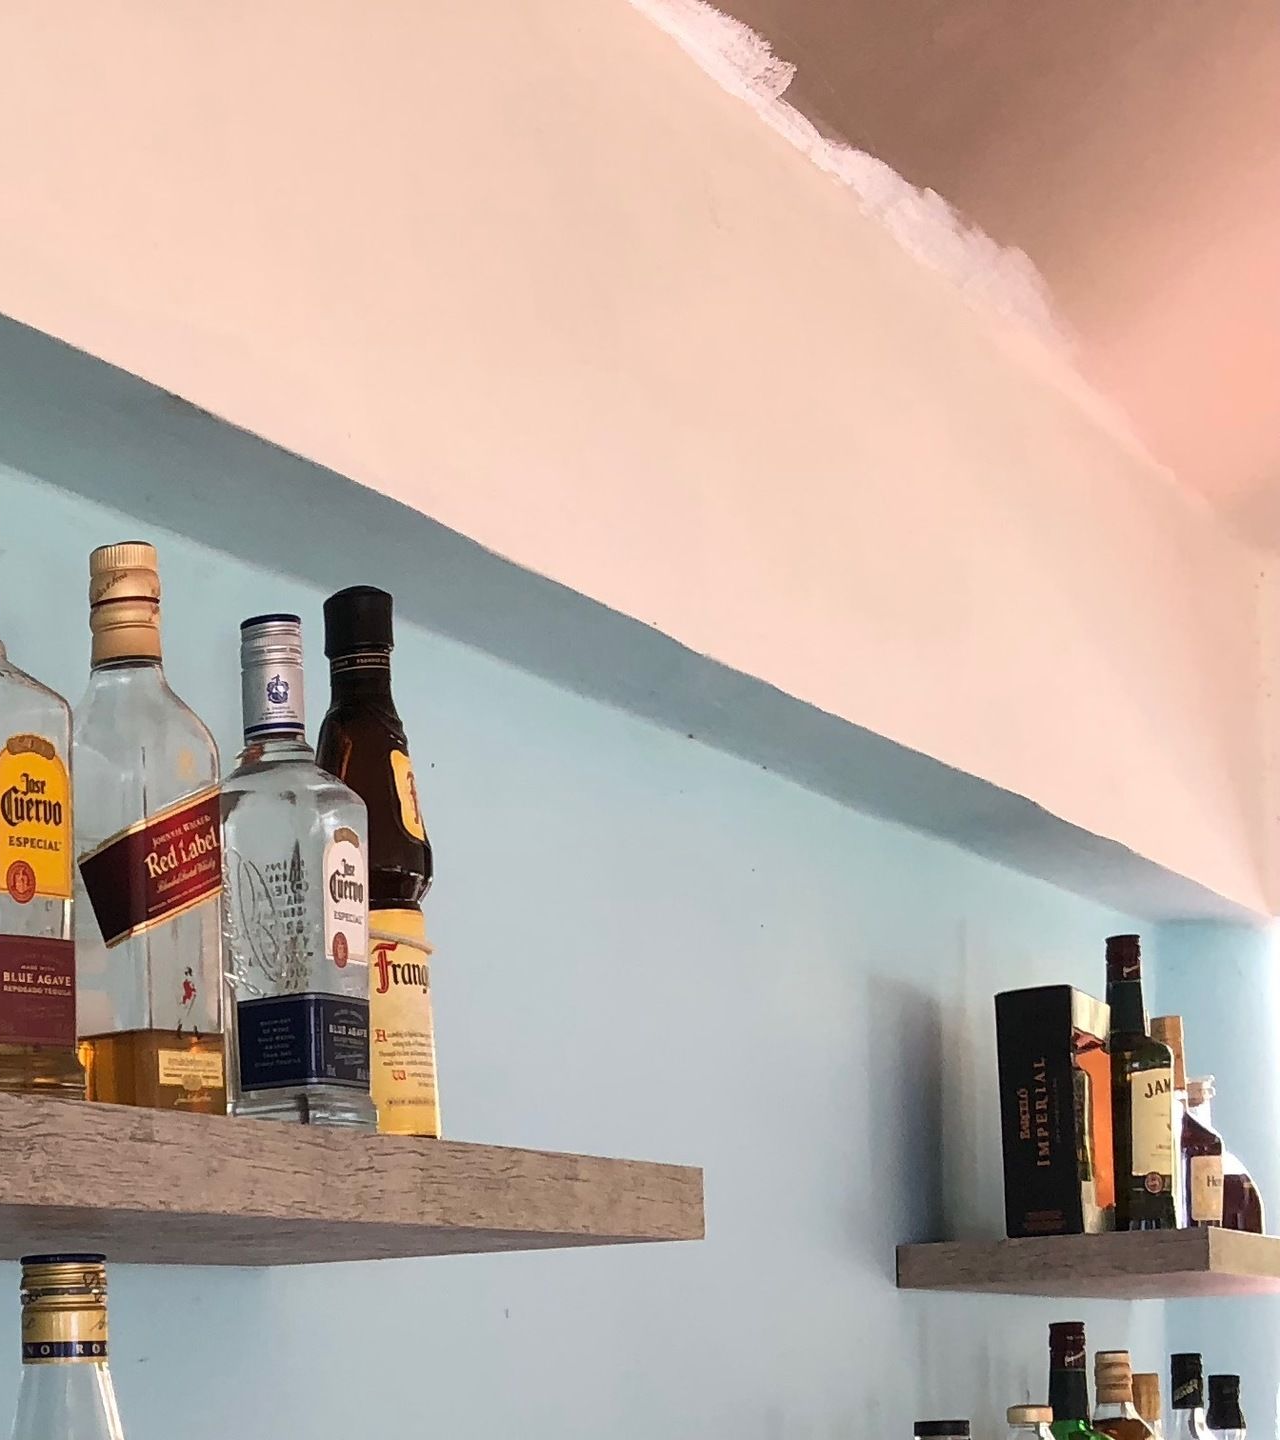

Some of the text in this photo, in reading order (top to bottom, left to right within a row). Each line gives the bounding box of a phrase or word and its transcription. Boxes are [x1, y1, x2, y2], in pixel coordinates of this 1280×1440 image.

[0, 785, 62, 827] Cuervo
[8, 835, 61, 852] ESPECIAL
[144, 843, 179, 879] Red
[178, 824, 219, 864] Label
[329, 869, 364, 904] Cuervo
[3, 971, 72, 987] BLUE AGAVE
[1033, 1056, 1052, 1167] IMPERIAL
